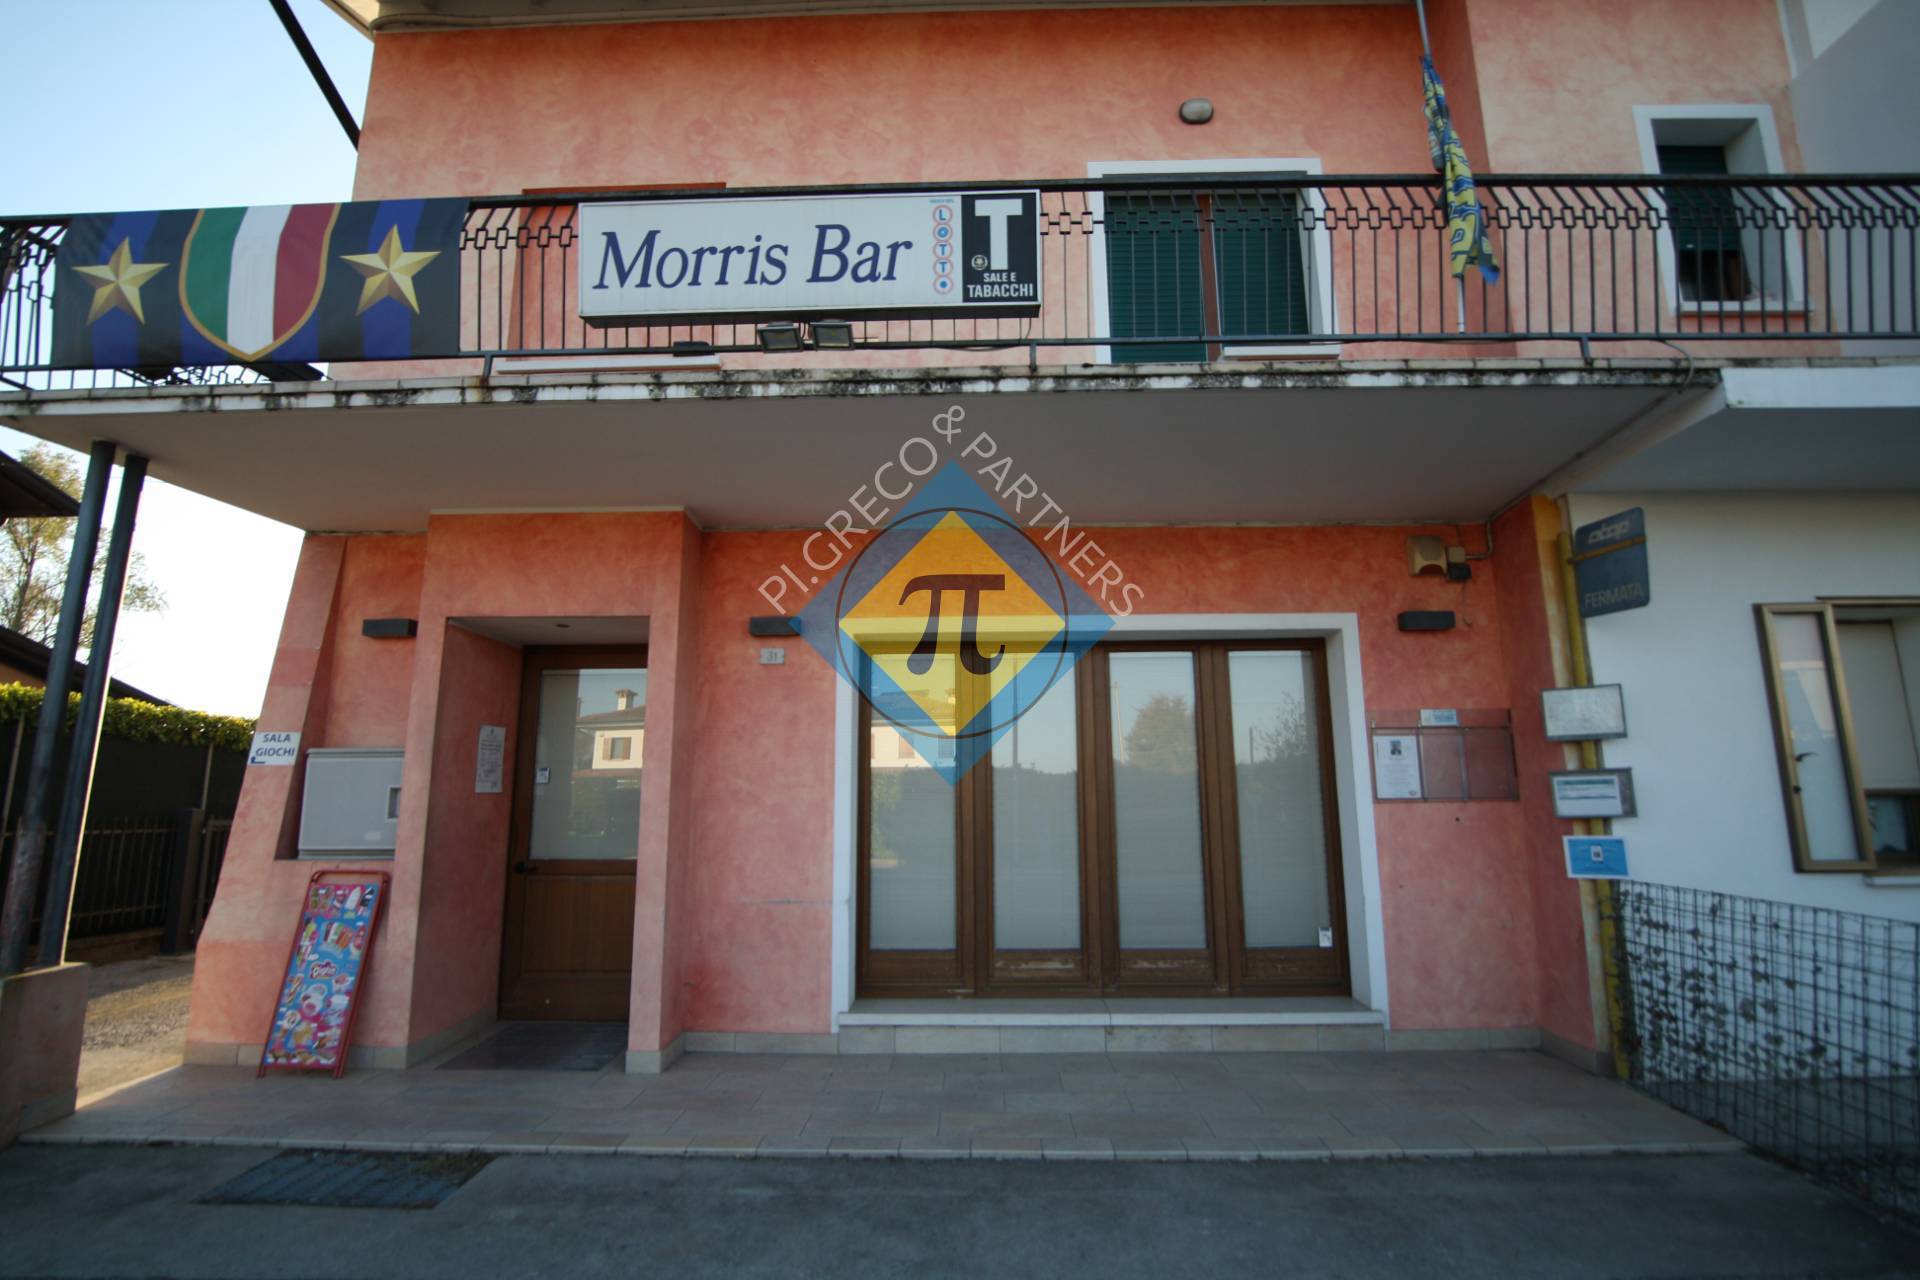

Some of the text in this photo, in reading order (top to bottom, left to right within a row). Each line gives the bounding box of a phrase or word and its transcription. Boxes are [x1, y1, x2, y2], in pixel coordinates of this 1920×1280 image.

[975, 199, 1023, 270] T
[592, 223, 913, 290] Morris Bar
[983, 272, 1017, 282] SALE E
[967, 283, 1034, 298] TABACCHI
[263, 733, 291, 743] SALA
[255, 747, 295, 757] GIOCHI
